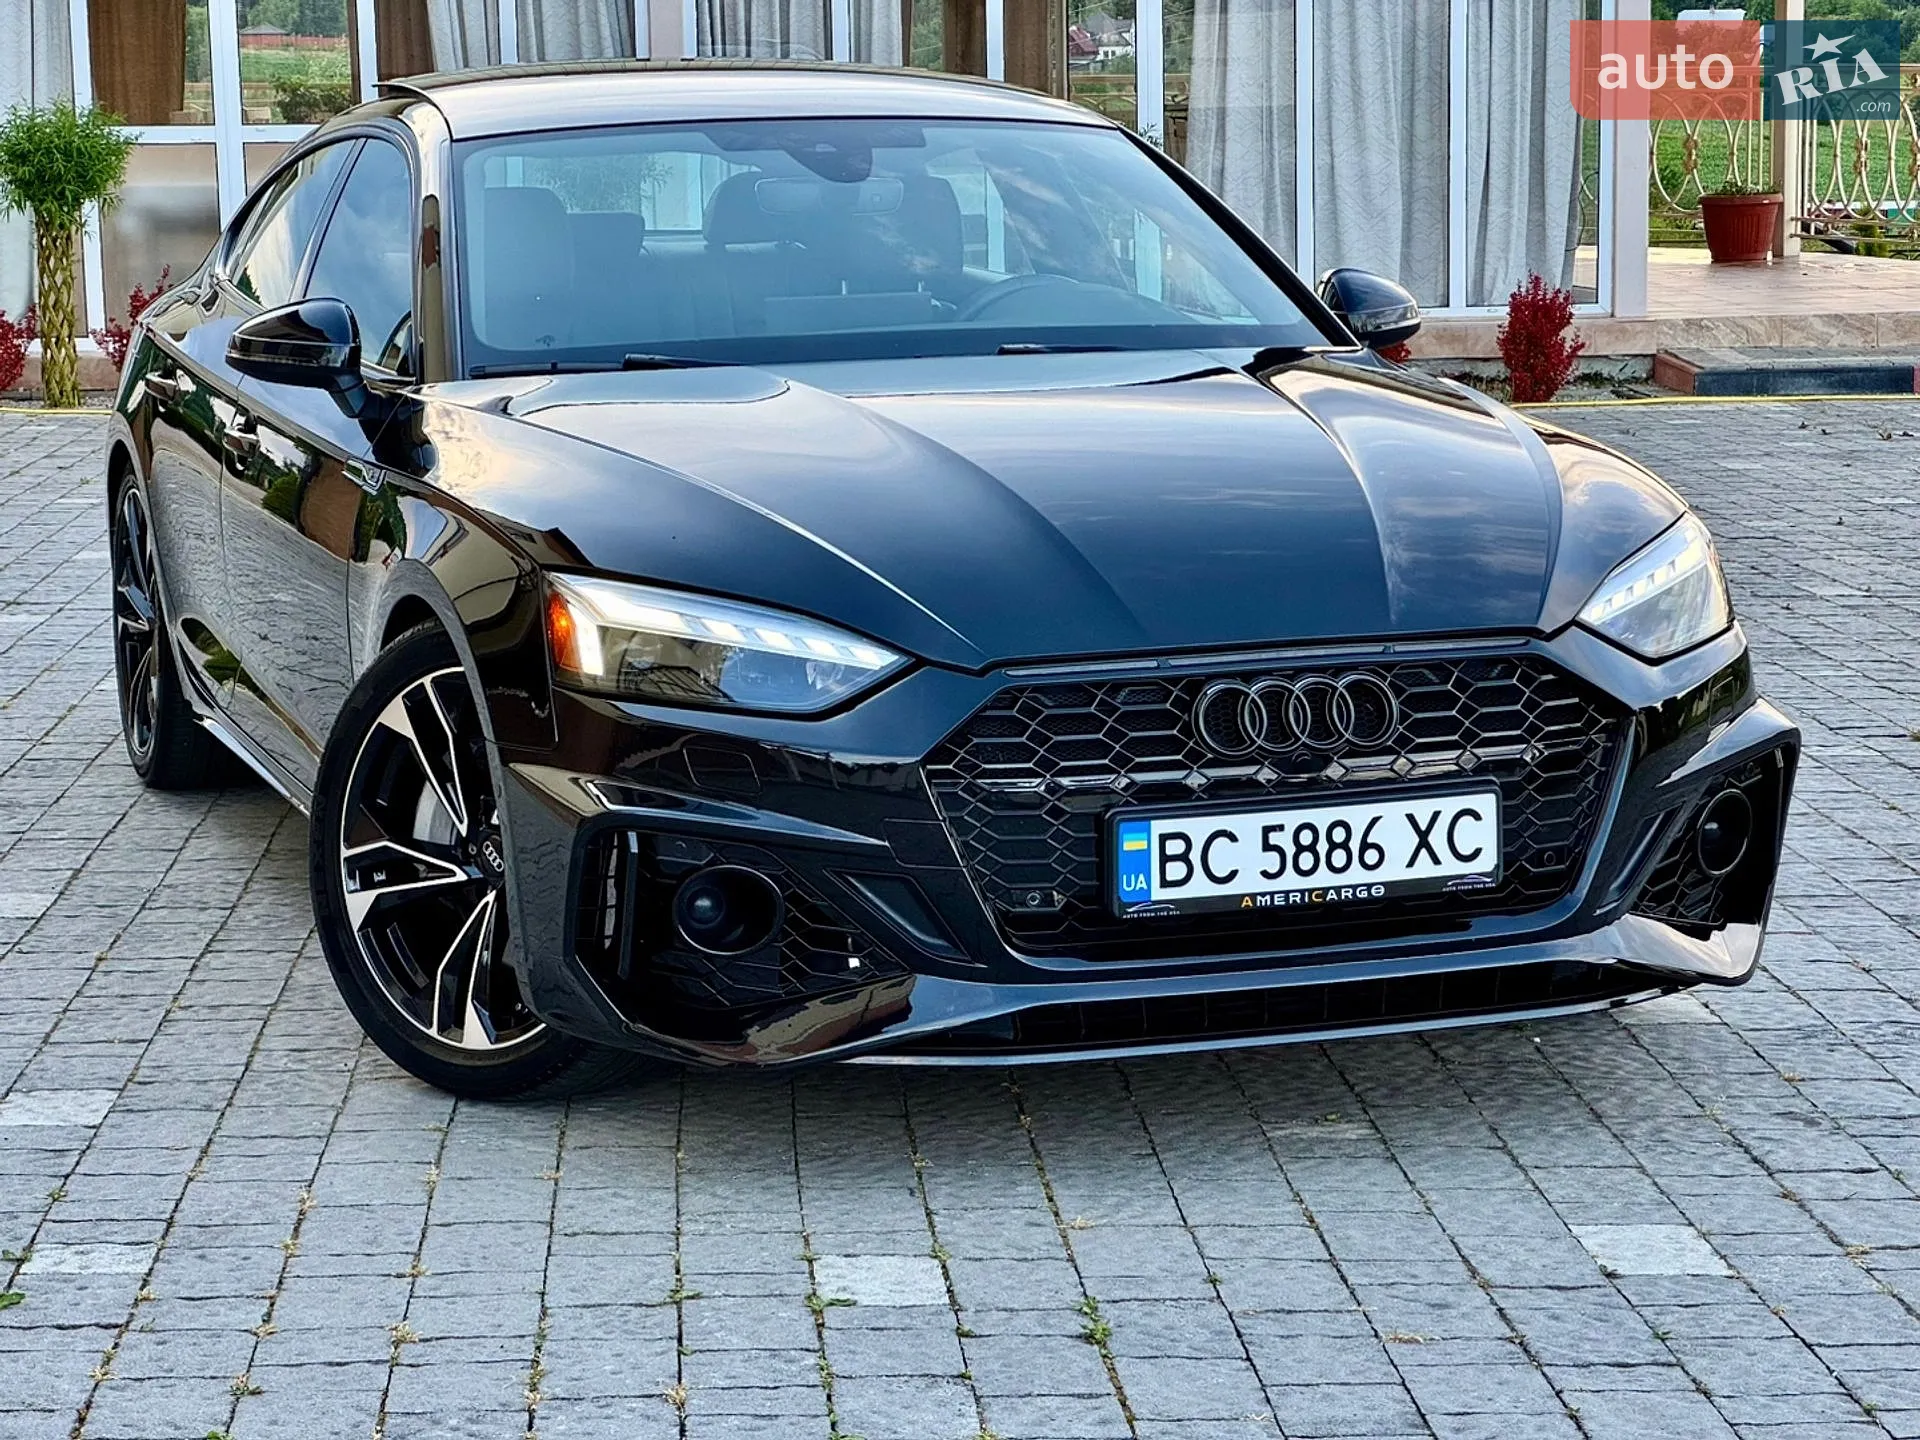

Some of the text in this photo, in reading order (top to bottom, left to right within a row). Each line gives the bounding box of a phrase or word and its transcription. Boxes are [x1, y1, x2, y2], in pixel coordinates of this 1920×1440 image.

[1158, 808, 1483, 889] BC 5886 XC
[1122, 873, 1148, 891] UA
